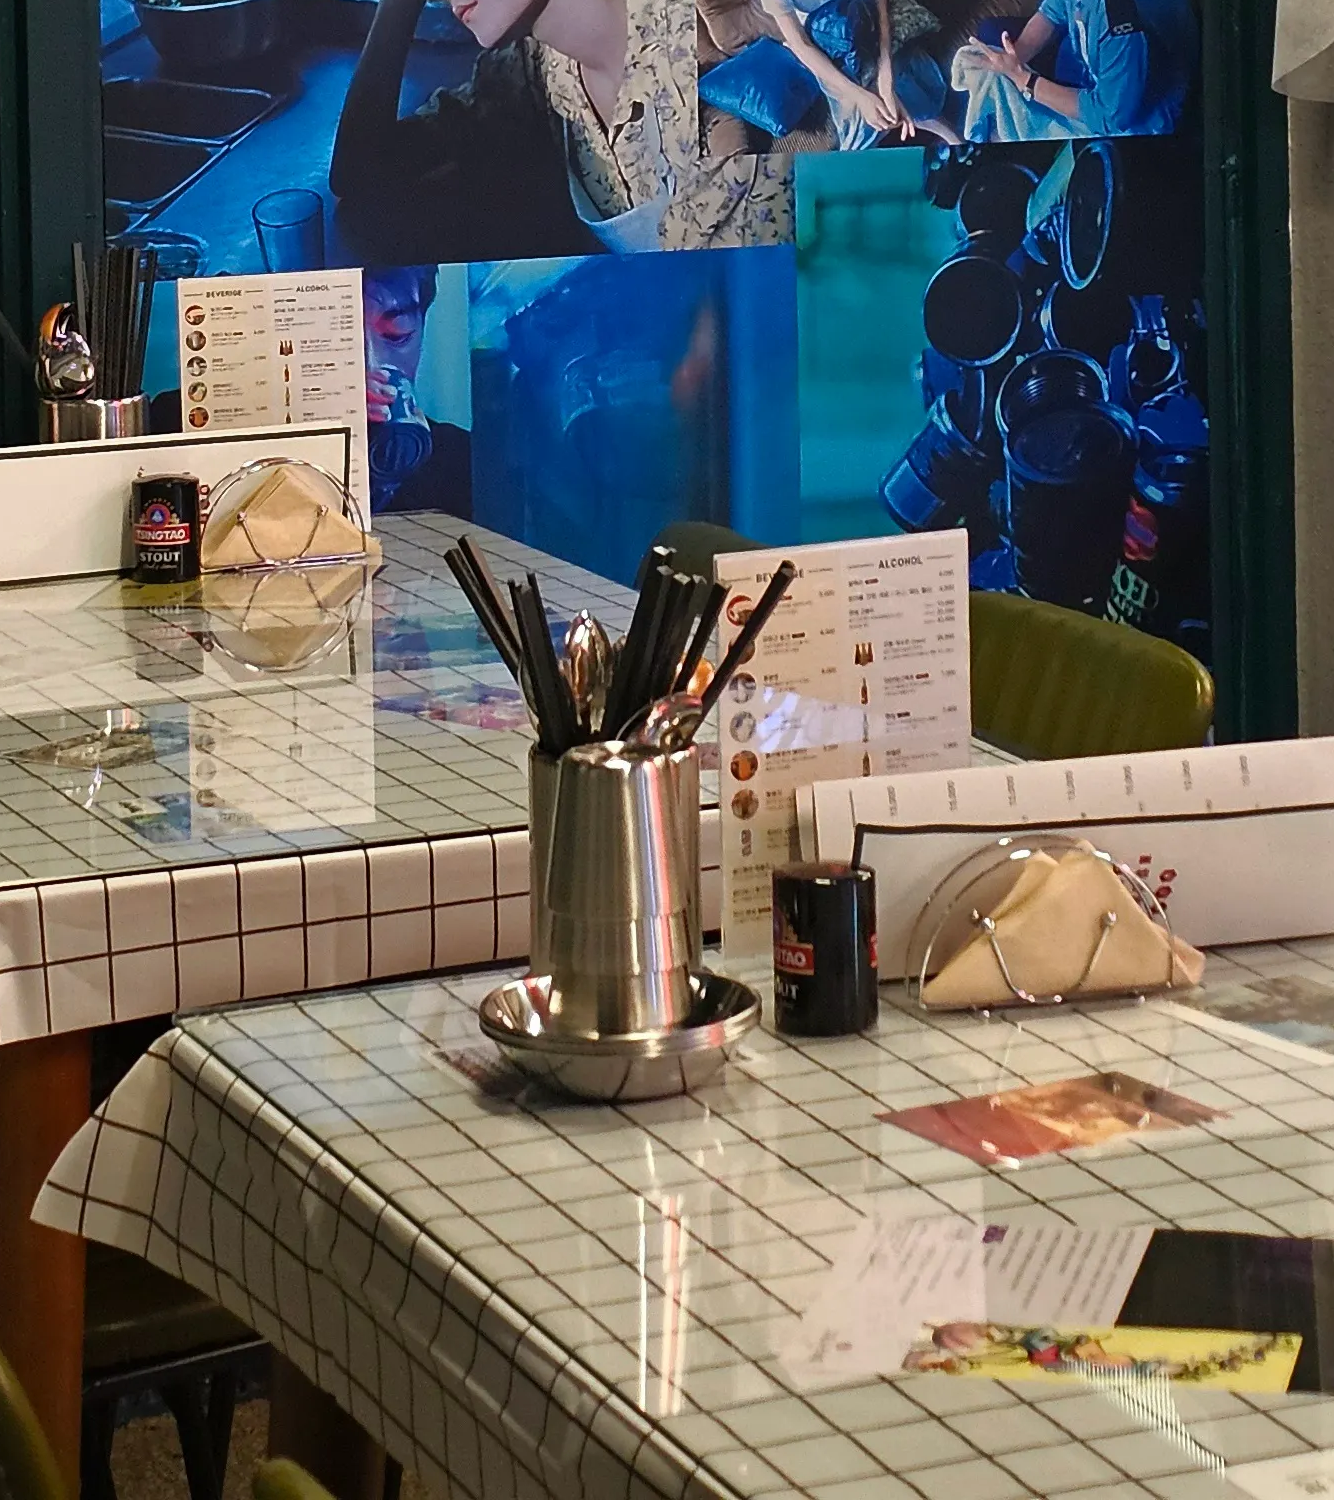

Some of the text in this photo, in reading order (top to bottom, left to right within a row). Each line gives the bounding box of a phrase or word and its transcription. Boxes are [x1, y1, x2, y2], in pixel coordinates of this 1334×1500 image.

[136, 528, 186, 541] TSINGTAO
[139, 551, 181, 563] STOUT
[878, 555, 924, 570] ALCOHOL
